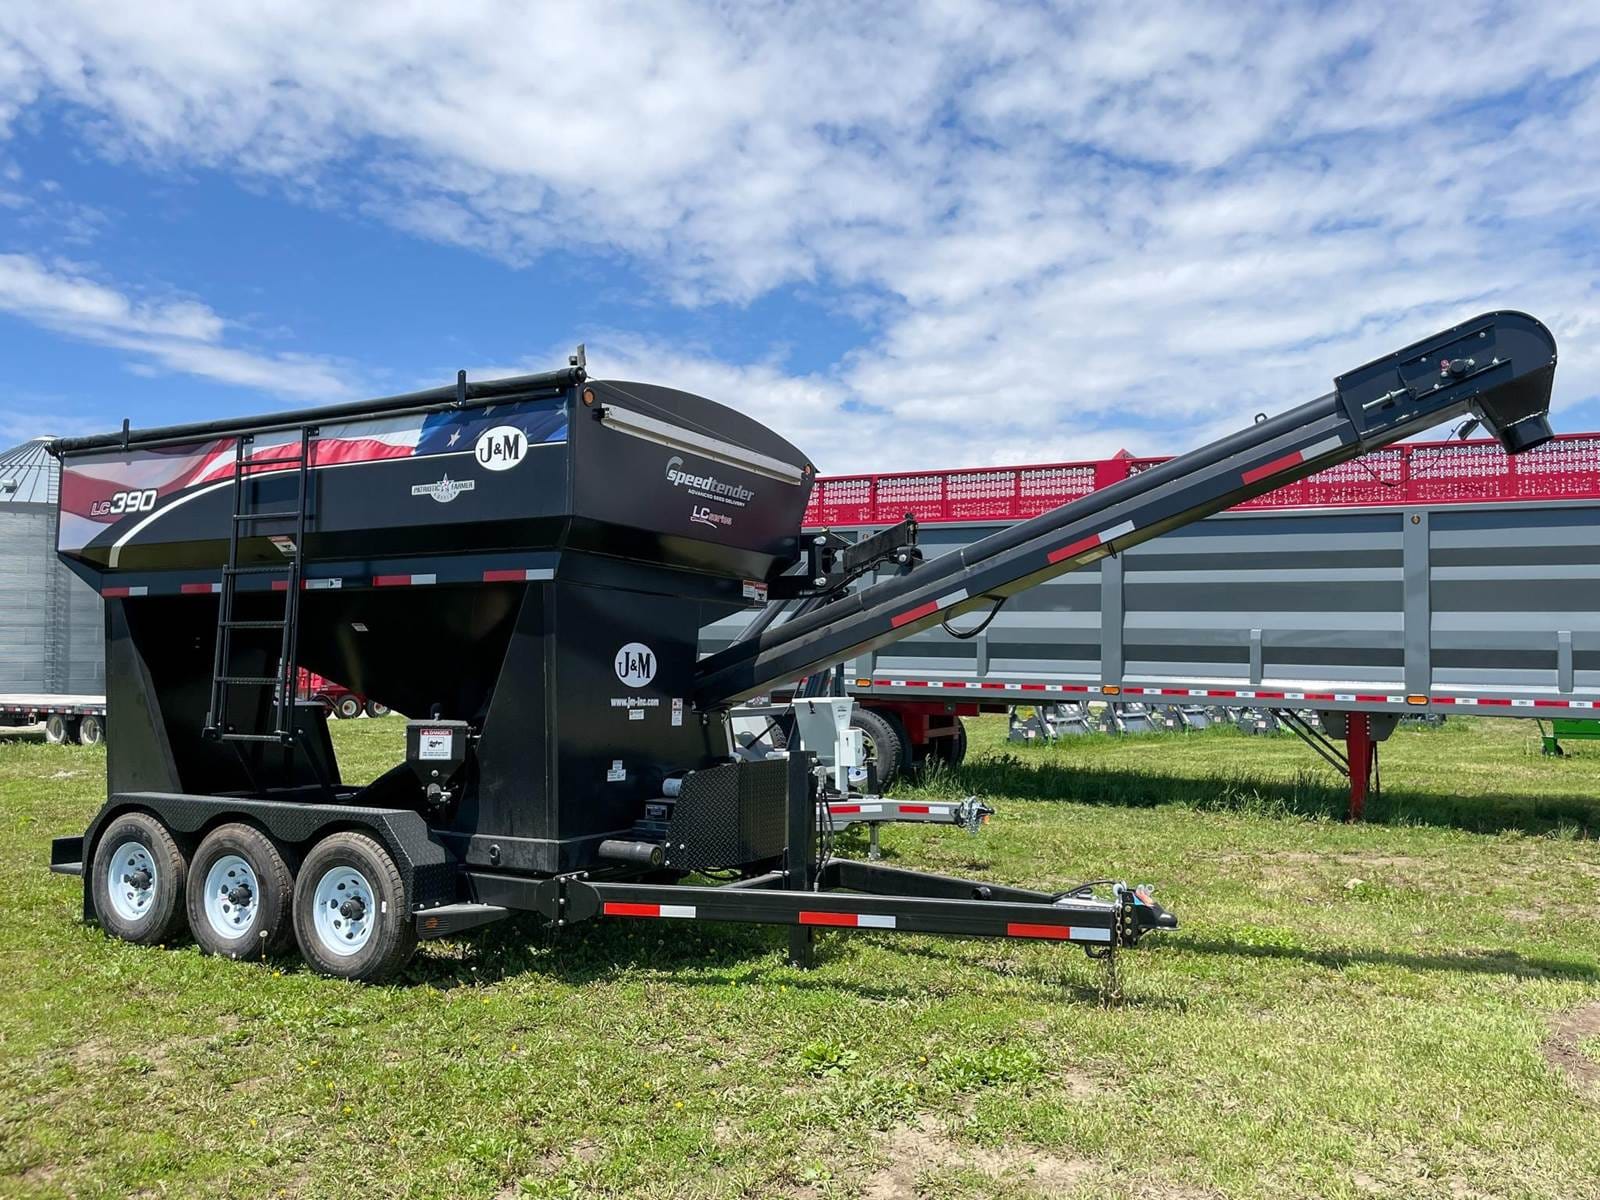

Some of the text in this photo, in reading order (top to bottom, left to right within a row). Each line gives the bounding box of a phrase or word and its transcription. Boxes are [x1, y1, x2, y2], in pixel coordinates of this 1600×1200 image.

[479, 433, 522, 463] J&M
[413, 481, 473, 494] PATRIOTIC FARMER
[688, 489, 713, 500] ADVANCED
[725, 498, 745, 507] DELIVERY
[618, 651, 652, 679] J&M
[610, 696, 660, 709] www.jm-inc.com
